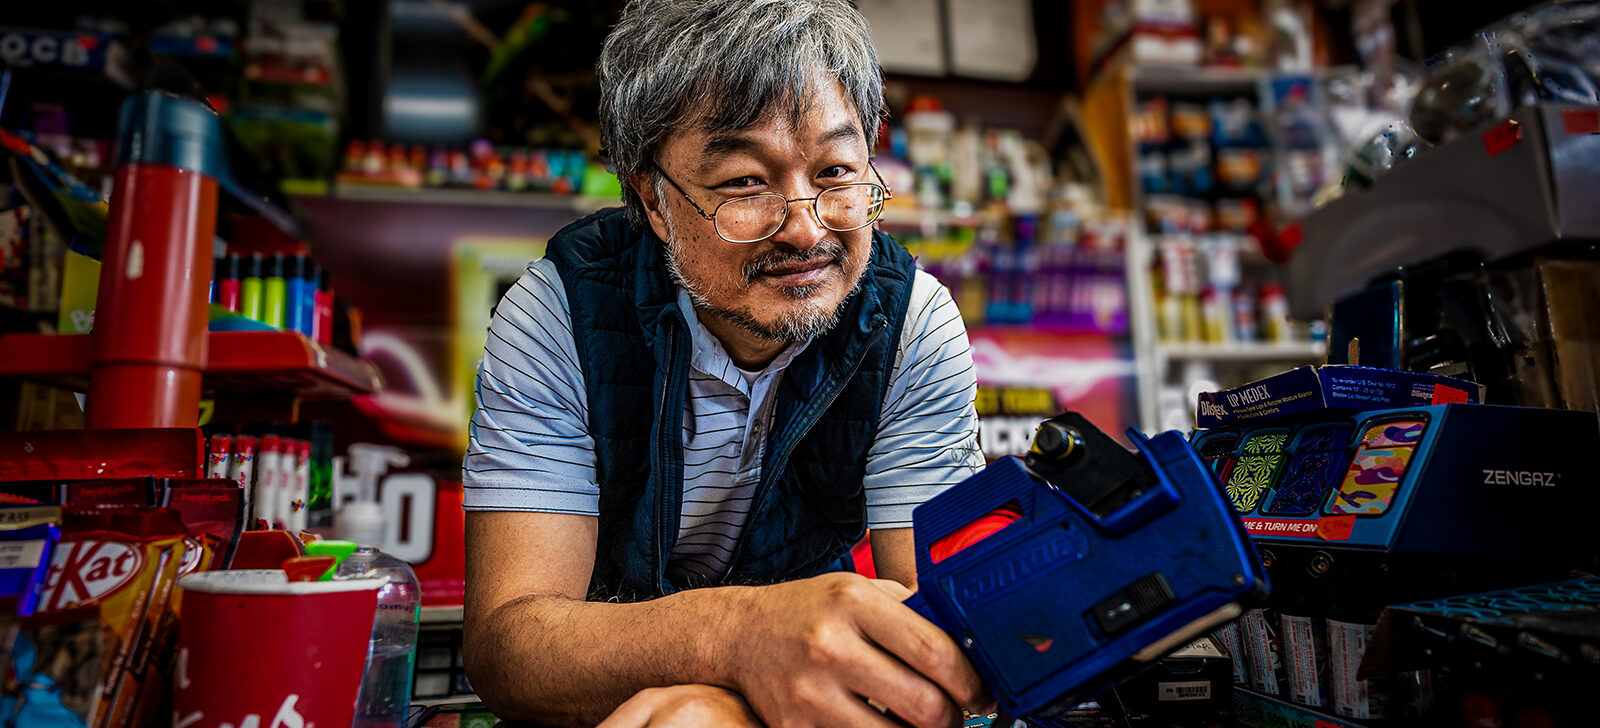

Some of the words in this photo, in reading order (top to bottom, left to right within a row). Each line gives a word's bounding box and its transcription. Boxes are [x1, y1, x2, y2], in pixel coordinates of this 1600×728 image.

[1238, 384, 1271, 405] MEDEX
[1200, 400, 1229, 420] Blistex
[1481, 468, 1557, 488] ZENGAZ
[1255, 521, 1263, 531] &
[1264, 522, 1287, 532] TURN
[1287, 523, 1302, 533] ME
[45, 540, 135, 612] tKat
